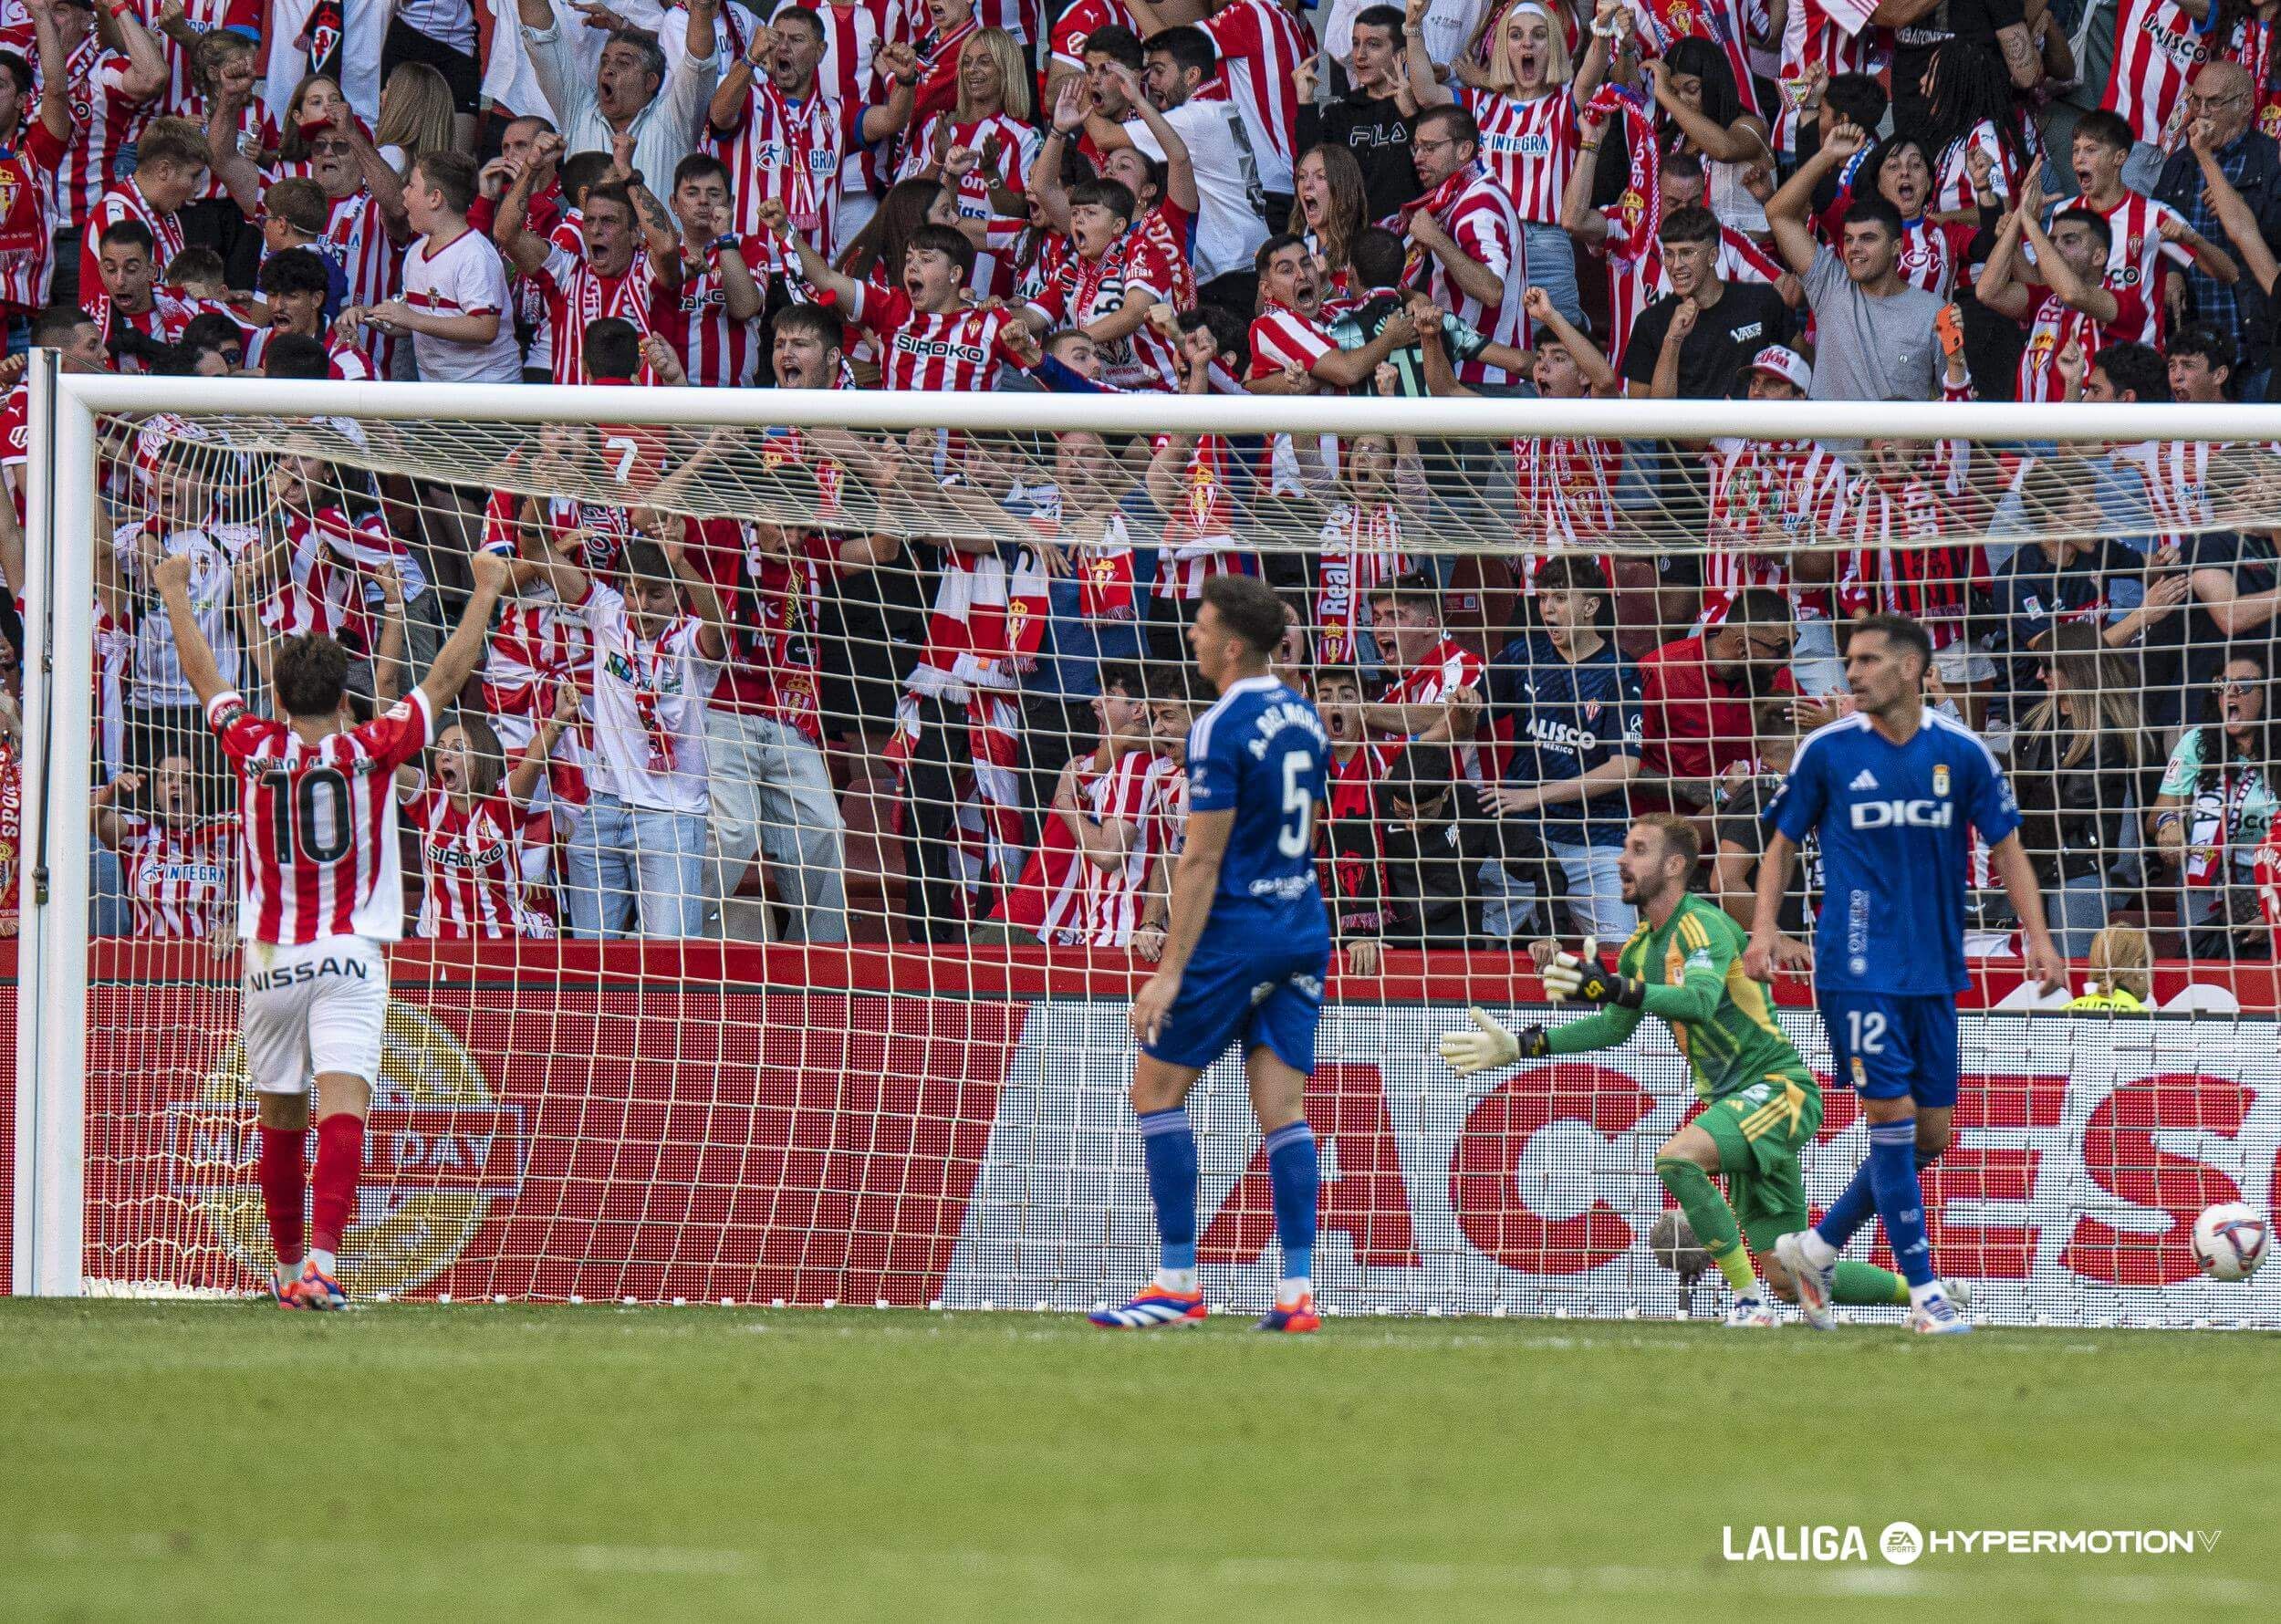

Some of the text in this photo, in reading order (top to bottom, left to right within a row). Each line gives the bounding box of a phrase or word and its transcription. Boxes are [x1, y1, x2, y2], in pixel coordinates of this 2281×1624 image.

[1350, 121, 1408, 147] FILA
[1492, 136, 1549, 151] INTEGRA
[896, 332, 985, 364] SIROKO
[605, 437, 638, 485] 7
[259, 766, 354, 864] 10
[1277, 750, 1313, 859] 5
[1850, 799, 1954, 829] DIGI
[427, 843, 505, 867] SIROKO
[164, 865, 226, 882] INTEGRA
[251, 956, 367, 994] NISSAN
[1847, 1010, 1887, 1055] 12
[391, 1131, 486, 1167] DAY
